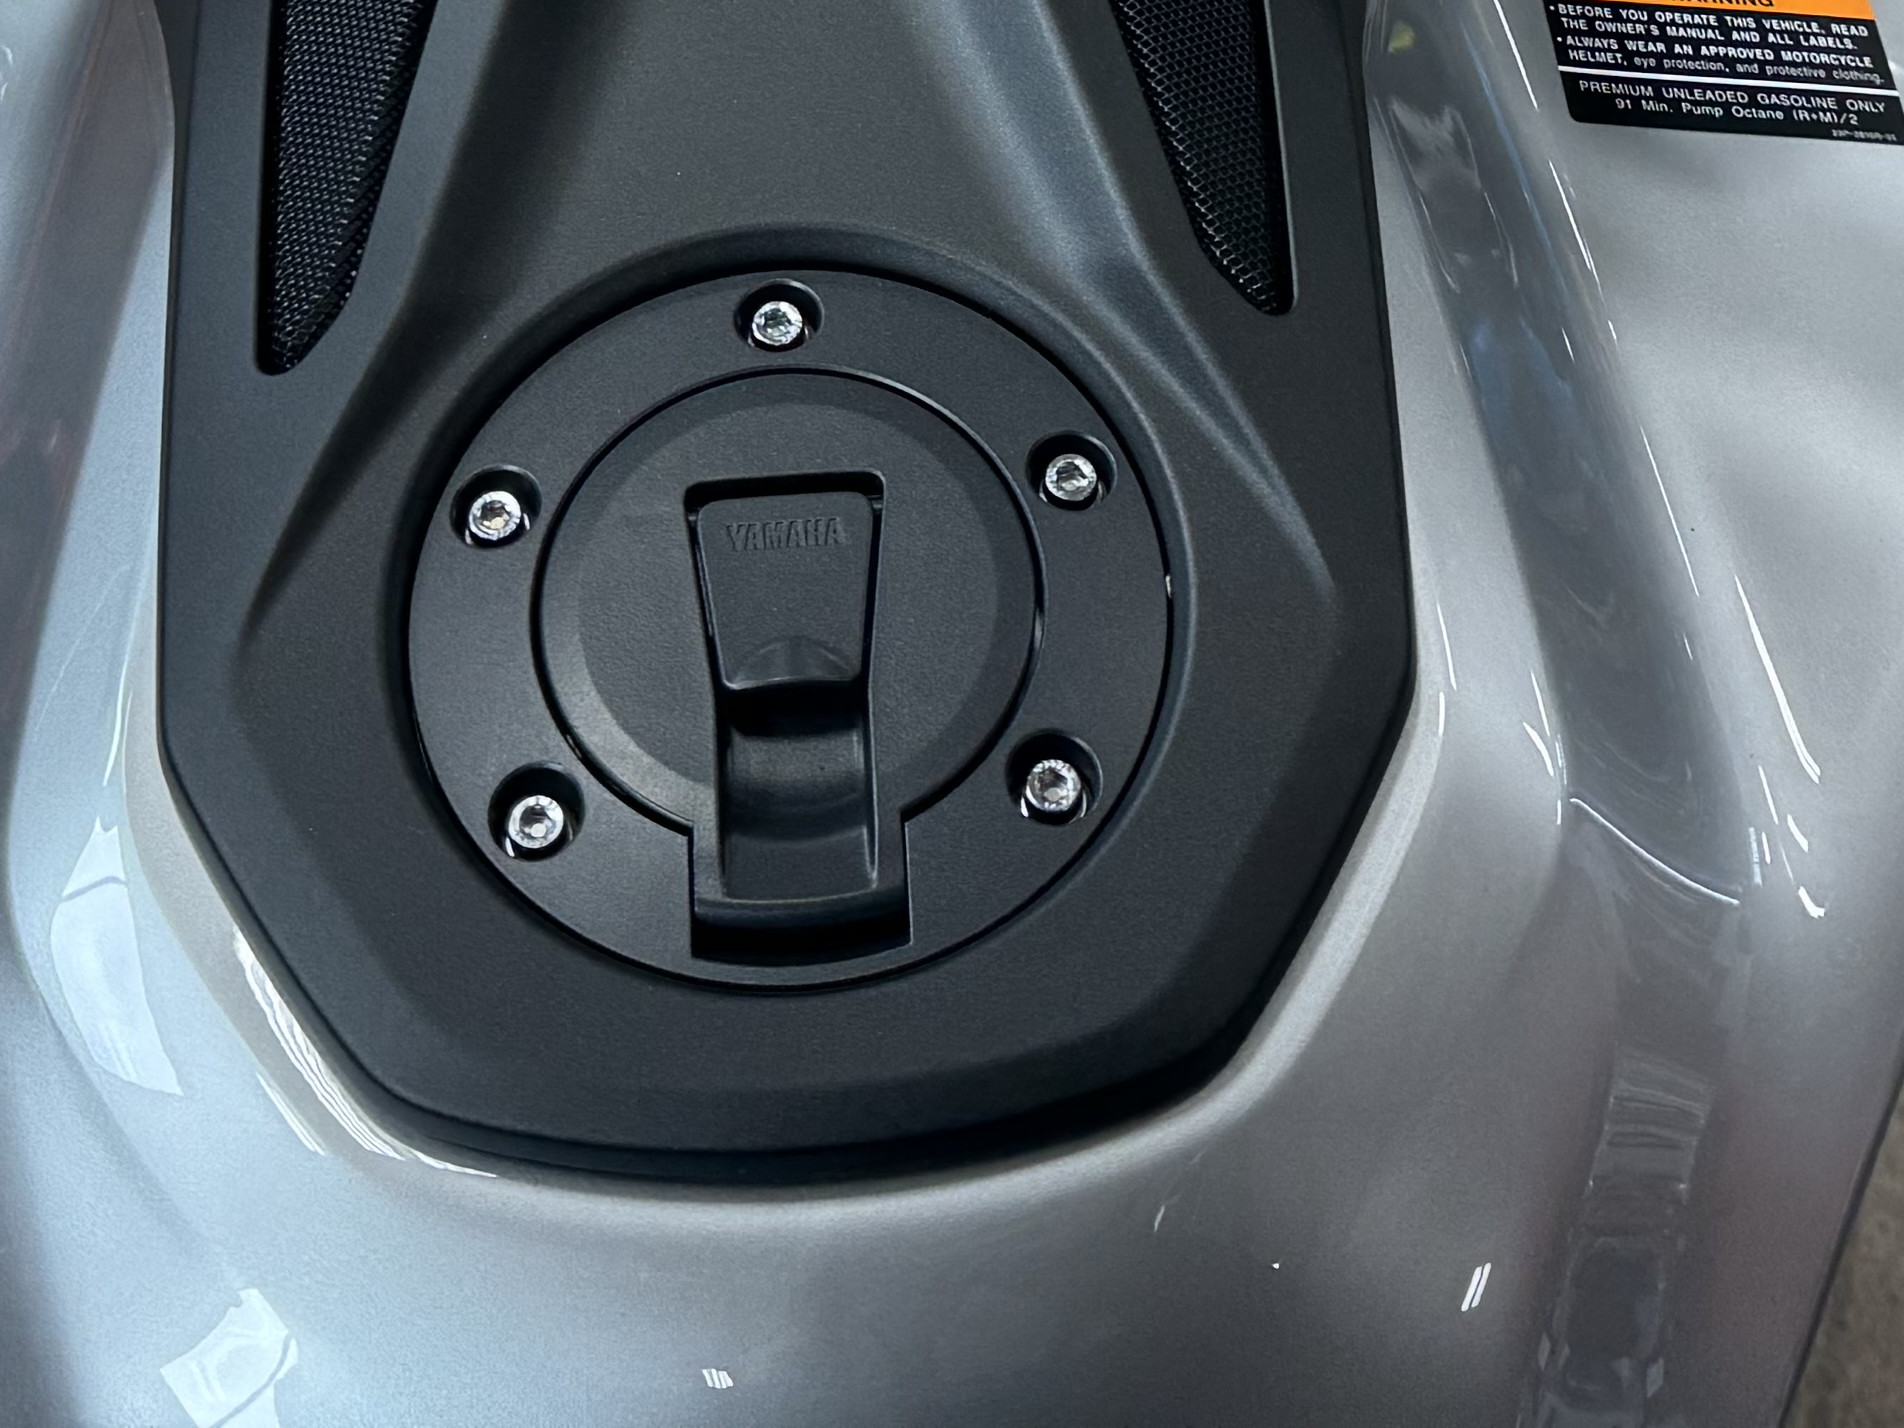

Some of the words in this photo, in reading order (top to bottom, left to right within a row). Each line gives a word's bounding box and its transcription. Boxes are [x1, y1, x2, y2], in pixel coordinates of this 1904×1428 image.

[1559, 3, 1613, 19] BEFORE
[1619, 9, 1648, 21] YOU
[1655, 11, 1719, 26] OPERATE
[1724, 15, 1756, 29] THIS
[1831, 23, 1869, 37] READ
[1560, 18, 1589, 31] THE
[1596, 21, 1660, 37] OWNER'S
[1666, 25, 1725, 41] MANUAL
[1732, 30, 1761, 43] AND
[1767, 32, 1793, 45] ALL
[1799, 35, 1858, 51] LABELS.
[1566, 35, 1619, 50] ALWAYS
[1624, 40, 1667, 54] WEAR
[1673, 44, 1694, 56] AN
[1700, 45, 1775, 61] APPROVED
[1780, 50, 1874, 69] MOTORCYCLE
[1634, 57, 1656, 70] eye
[1736, 63, 1759, 75] and
[1765, 64, 1826, 80] protective
[1832, 69, 1885, 86] clothing.
[1579, 79, 1654, 98] PREMIUM
[1662, 86, 1749, 104] UNLEADED
[1757, 93, 1838, 110] GASOLINE
[1846, 99, 1885, 114] ONLY
[1615, 98, 1632, 111] 91
[1641, 99, 1674, 114] Min.
[1682, 102, 1724, 119] Pump
[1731, 105, 1785, 121] Octane
[725, 516, 842, 552] YAMAHA
